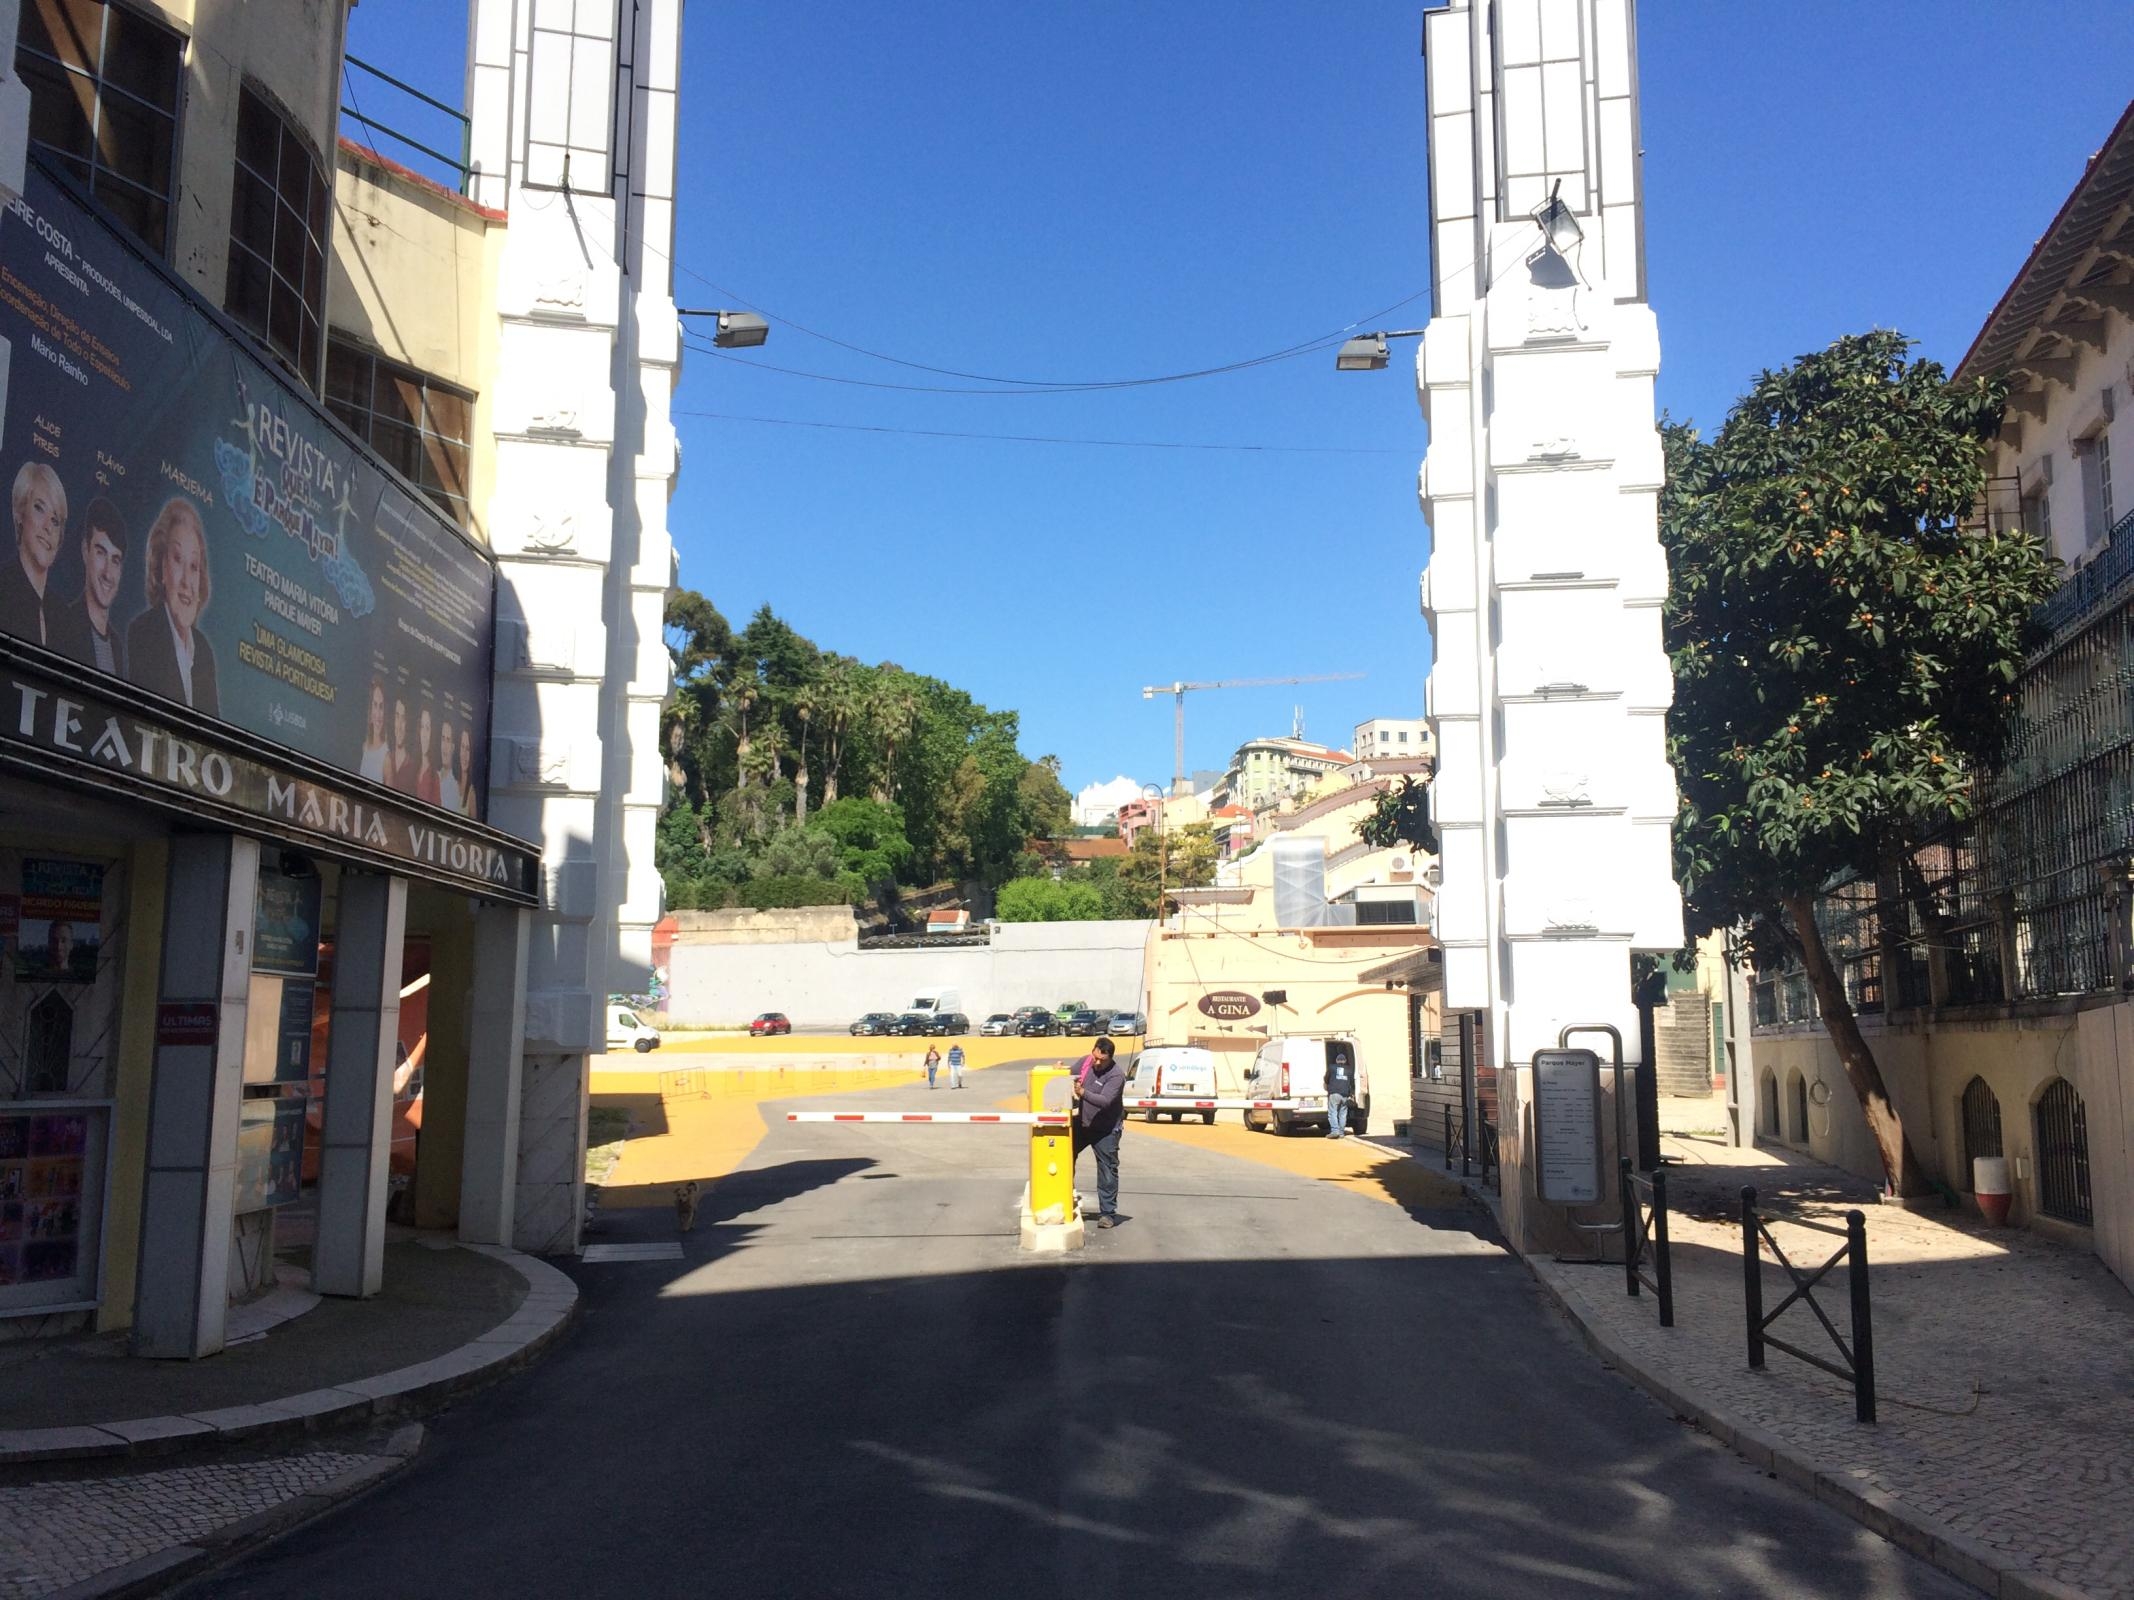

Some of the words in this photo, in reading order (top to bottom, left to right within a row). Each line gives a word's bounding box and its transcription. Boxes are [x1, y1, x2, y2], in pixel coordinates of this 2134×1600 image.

[7, 198, 36, 229] EIRE
[35, 215, 73, 262] COSTA
[0, 283, 50, 333] oordenação
[51, 324, 62, 341] de
[63, 331, 82, 359] Todo
[80, 328, 91, 344] de
[31, 332, 57, 364] Mário
[58, 353, 89, 386] Rainho
[33, 432, 60, 458] PIRES
[34, 414, 62, 438] ALICE
[96, 450, 127, 476] FLÁVIO
[259, 403, 336, 499] REVISTA
[244, 553, 280, 590] TEATRO
[281, 575, 307, 607] MARIA
[308, 590, 339, 626] VITÓRIA
[264, 590, 297, 624] PARQUE
[297, 612, 322, 637] MAYER
[239, 640, 275, 675] REVISTA
[276, 636, 326, 677] GLAMOROSA
[12, 680, 234, 797] TEATRO
[267, 775, 388, 847] MARIA
[408, 824, 509, 882] VITÓRIA
[162, 1013, 213, 1027] ÚLTIMAS
[1207, 1004, 1216, 1014] A
[1217, 1004, 1251, 1015] GINA
